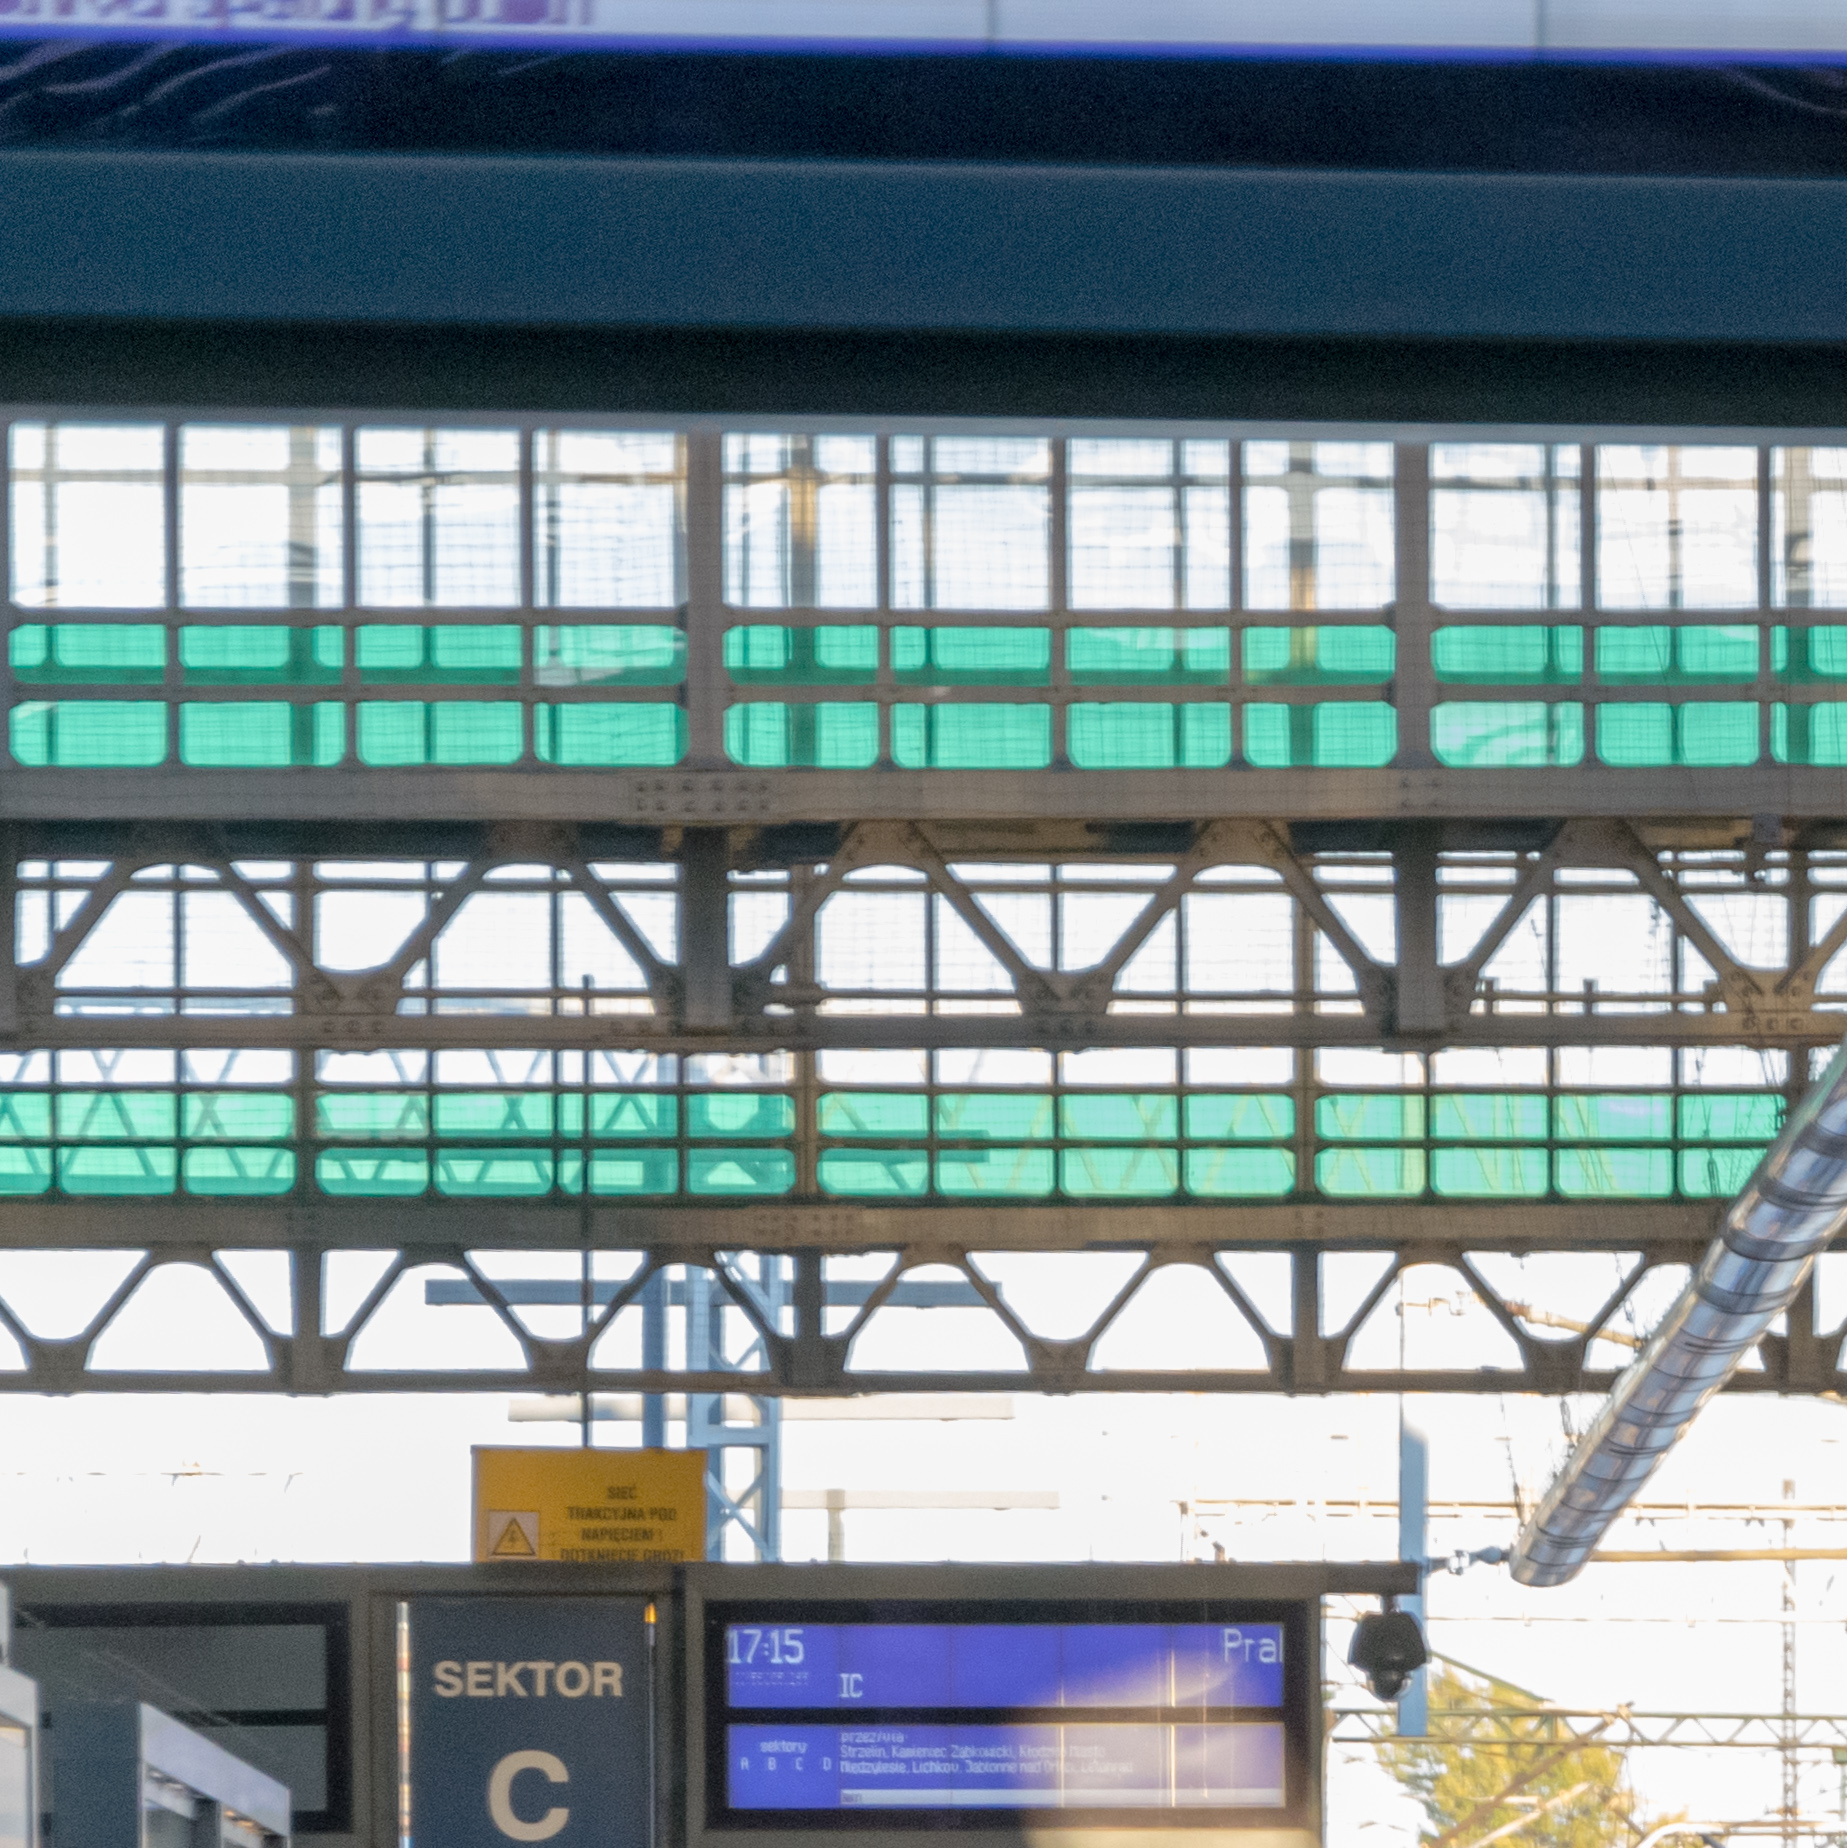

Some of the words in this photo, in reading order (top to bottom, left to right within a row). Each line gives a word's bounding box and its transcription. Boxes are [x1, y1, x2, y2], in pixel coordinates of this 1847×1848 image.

[728, 1628, 805, 1664] 17:15
[1224, 1628, 1283, 1664] Pra
[434, 1659, 624, 1698] SEKTOR
[839, 1672, 863, 1698] IC
[740, 1756, 750, 1771] A
[767, 1756, 777, 1771] B
[794, 1756, 804, 1771] C
[822, 1756, 832, 1771] D
[759, 1740, 808, 1756] sektory
[488, 1748, 571, 1842] C
